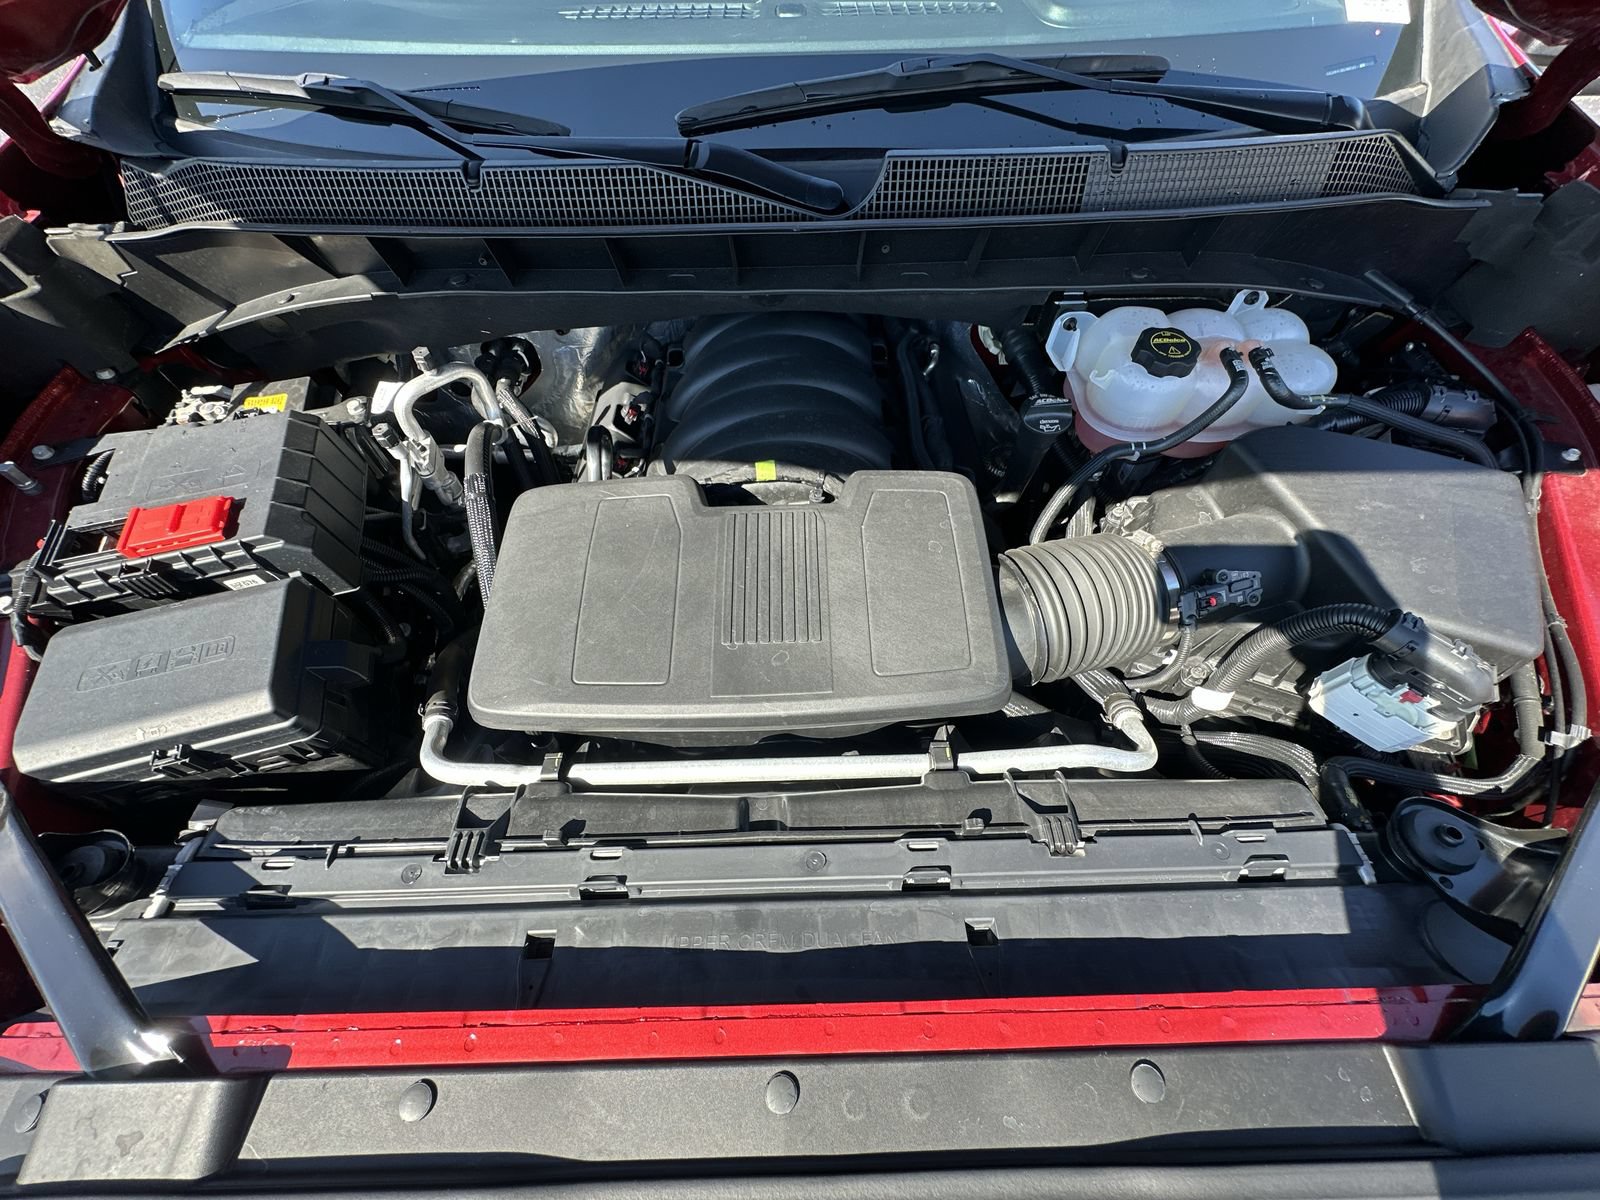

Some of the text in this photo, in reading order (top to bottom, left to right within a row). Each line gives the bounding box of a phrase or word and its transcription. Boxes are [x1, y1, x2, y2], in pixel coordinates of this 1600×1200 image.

[1034, 397, 1069, 406] ACDelco
[664, 934, 729, 950] UPPER
[860, 930, 897, 946] FAN
